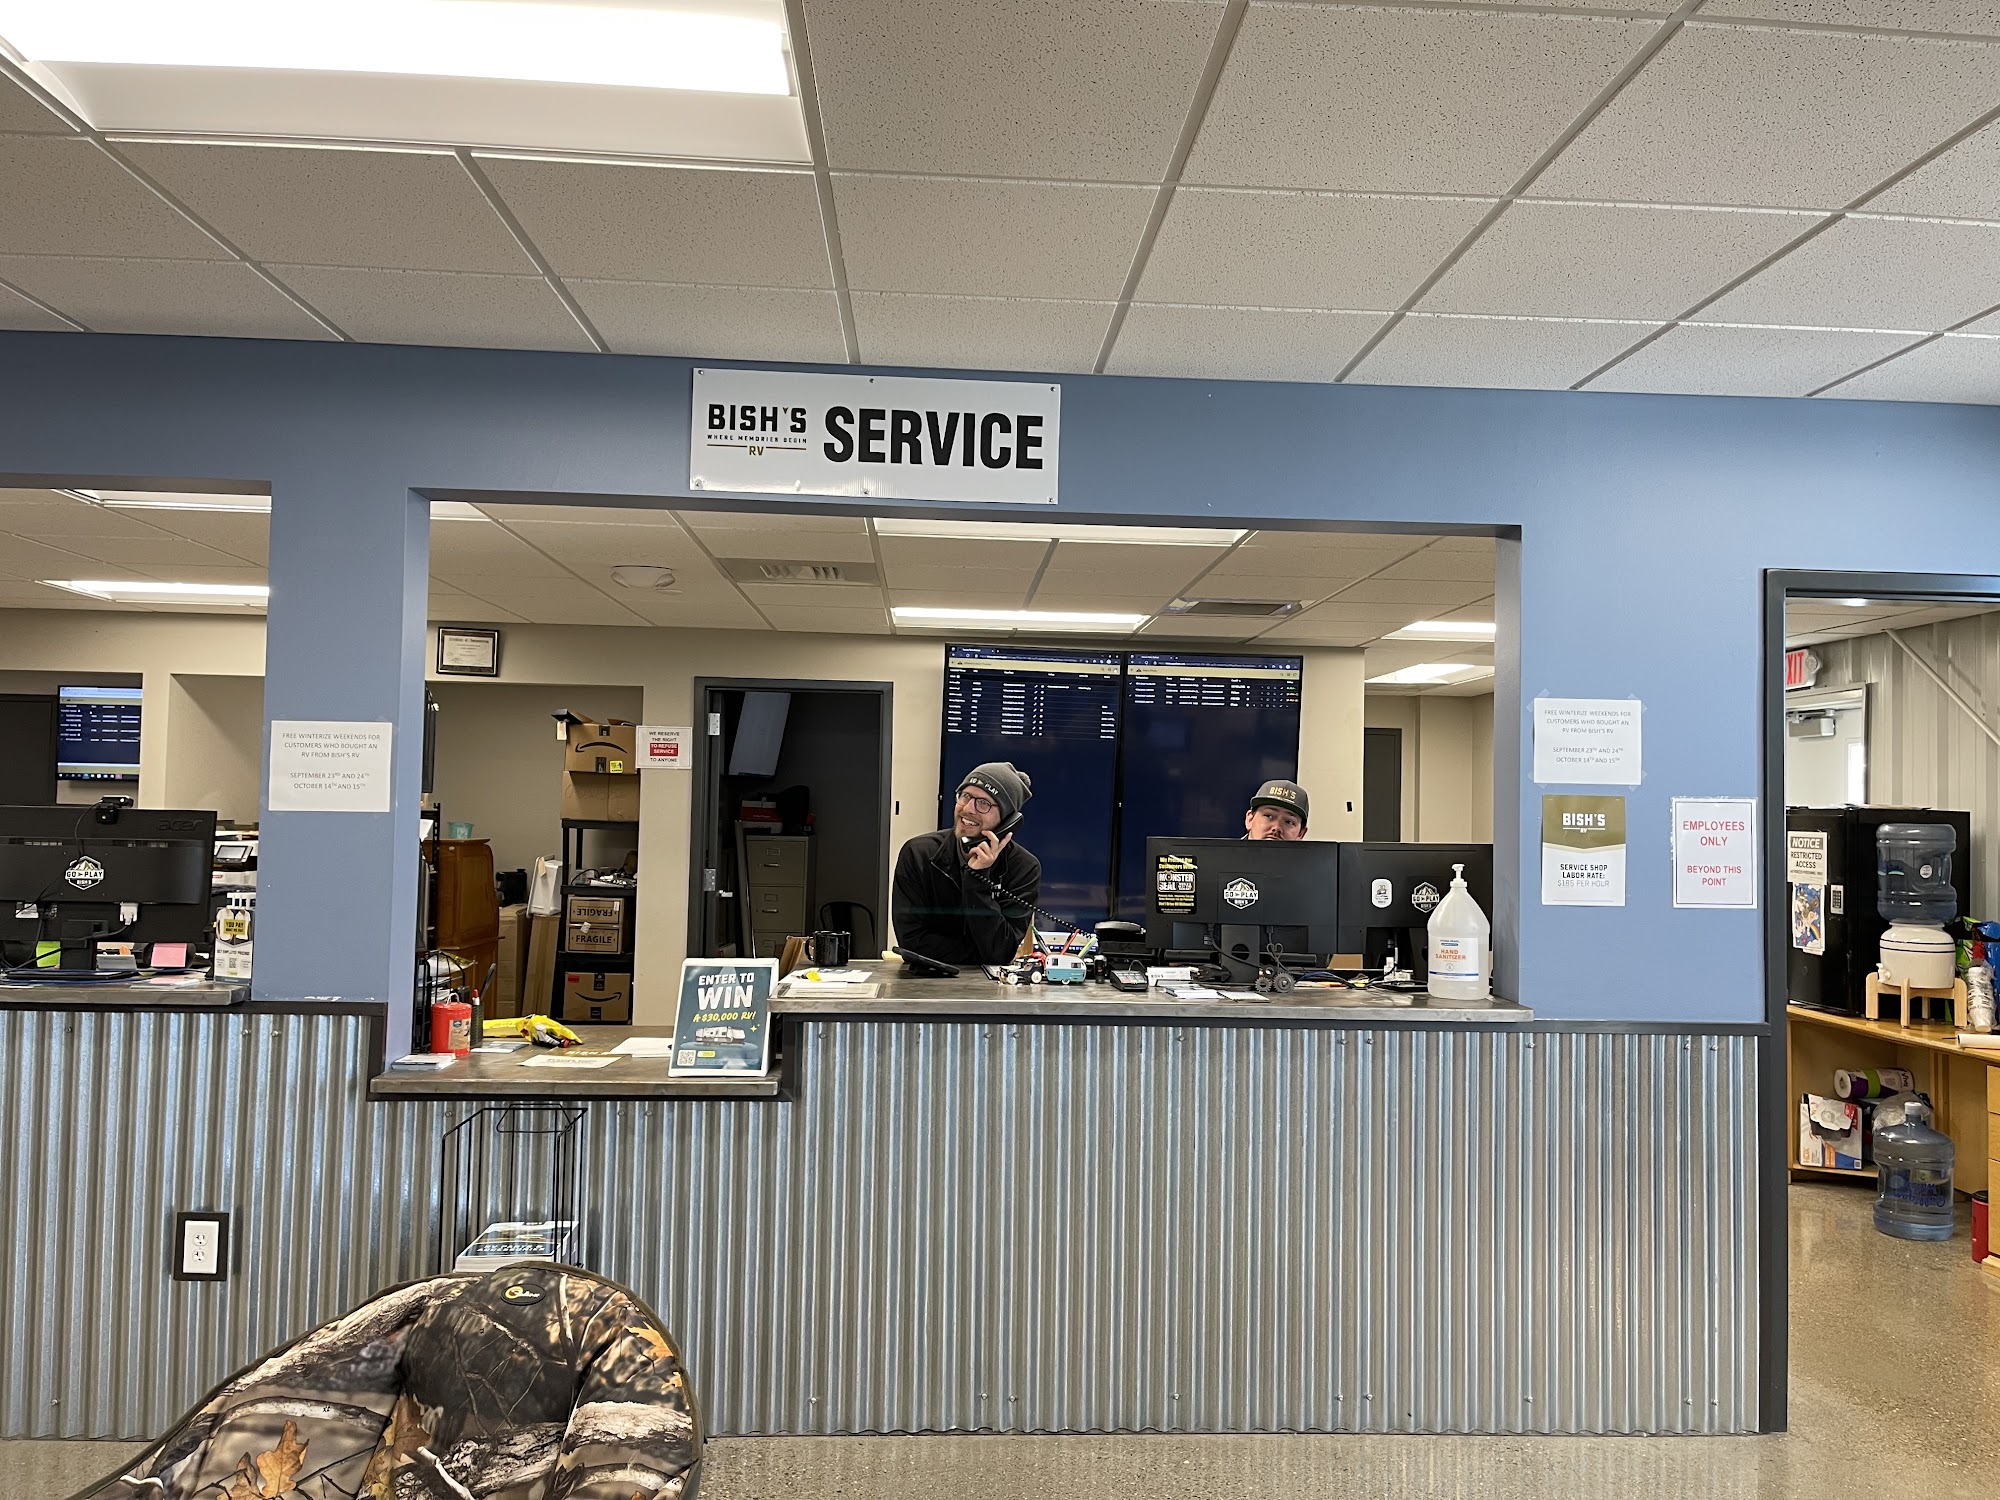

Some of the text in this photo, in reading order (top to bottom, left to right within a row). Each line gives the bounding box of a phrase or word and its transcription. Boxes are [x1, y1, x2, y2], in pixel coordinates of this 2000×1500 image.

[708, 404, 806, 433] BISH'S
[824, 406, 1043, 469] SERVICE
[749, 446, 764, 456] RV
[985, 784, 998, 795] PLAY
[1270, 786, 1297, 799] BISH'S
[158, 819, 202, 831] acer
[1562, 813, 1606, 827] BISH'S
[1683, 820, 1745, 831] EMPLOYEES
[1700, 836, 1728, 846] ONLY
[1792, 838, 1820, 848] NOTICE
[1791, 851, 1822, 860] RESTRICTED
[1687, 866, 1742, 874] BEYOND THIS
[1160, 874, 1193, 882] MONSTER
[1702, 878, 1726, 886] POINT
[1159, 882, 1176, 890] SEAL
[576, 935, 612, 943] FRAGILE
[698, 973, 755, 986] ENTER TO
[698, 985, 754, 1011] WIN
[693, 1011, 756, 1022] A $30,000 RV!
